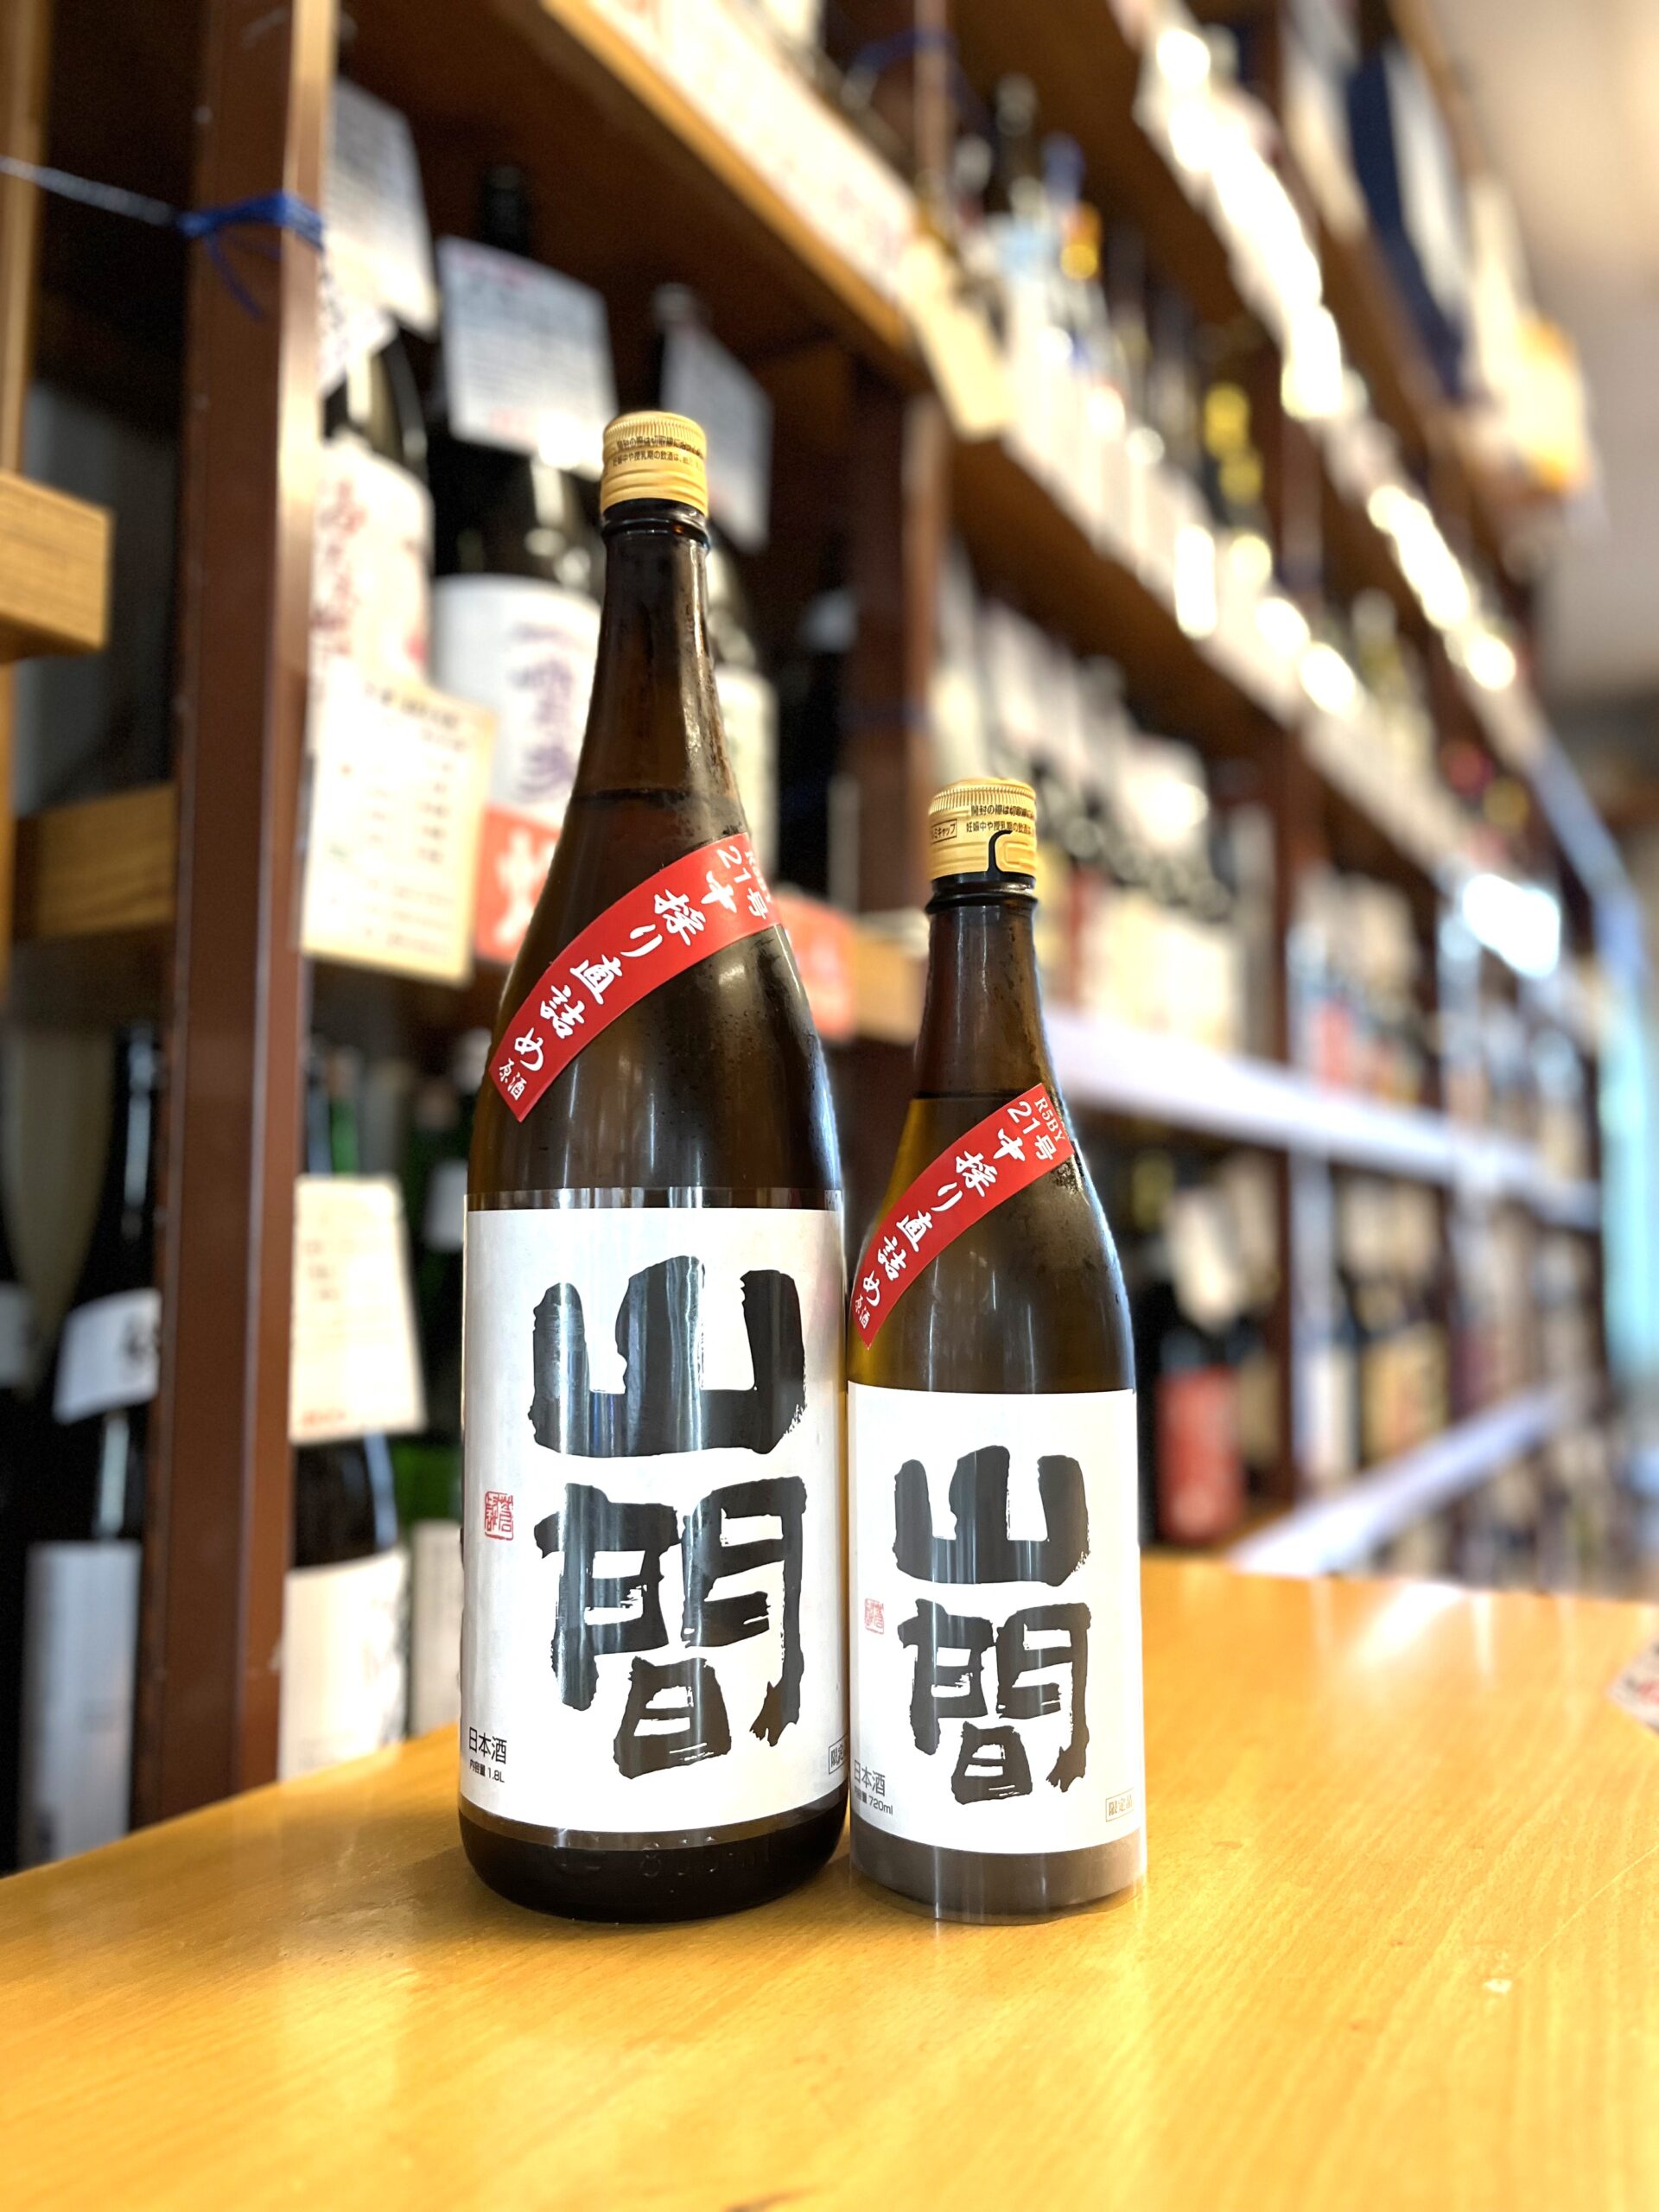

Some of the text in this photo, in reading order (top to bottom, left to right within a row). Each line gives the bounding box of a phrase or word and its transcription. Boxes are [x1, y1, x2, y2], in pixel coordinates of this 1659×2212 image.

[1007, 1101, 1057, 1160] 21号
[1034, 1096, 1065, 1141] R5BY
[469, 1726, 507, 1764] 日本酒
[854, 1759, 886, 1797] 日本酒
